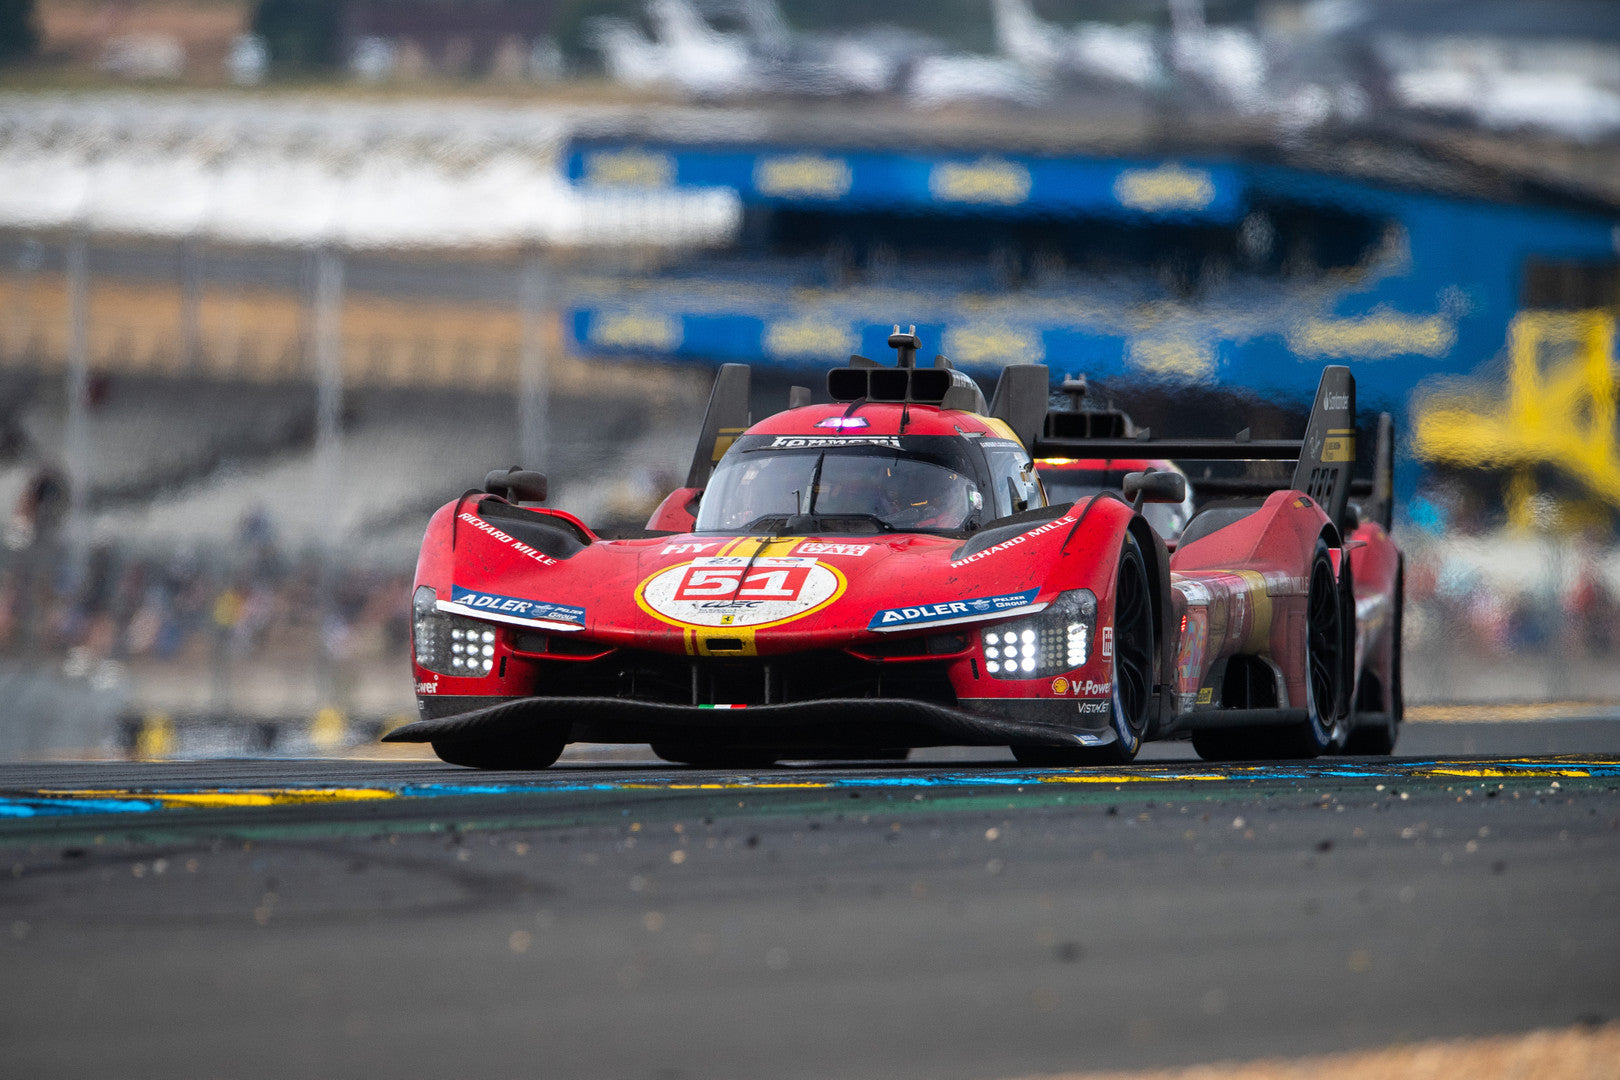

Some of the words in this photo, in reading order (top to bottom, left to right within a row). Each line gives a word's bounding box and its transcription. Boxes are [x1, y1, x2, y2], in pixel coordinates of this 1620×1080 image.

[457, 512, 511, 544] RICHARD
[510, 541, 557, 566] MILLE
[950, 536, 1026, 568] RICHARD
[1027, 515, 1078, 537] MILLE
[683, 570, 794, 597] 51
[453, 594, 534, 614] ADLER
[881, 602, 968, 623] ADLER
[992, 595, 1026, 603] PELZER
[995, 600, 1028, 608] GROUP
[1072, 680, 1112, 696] V-Power
